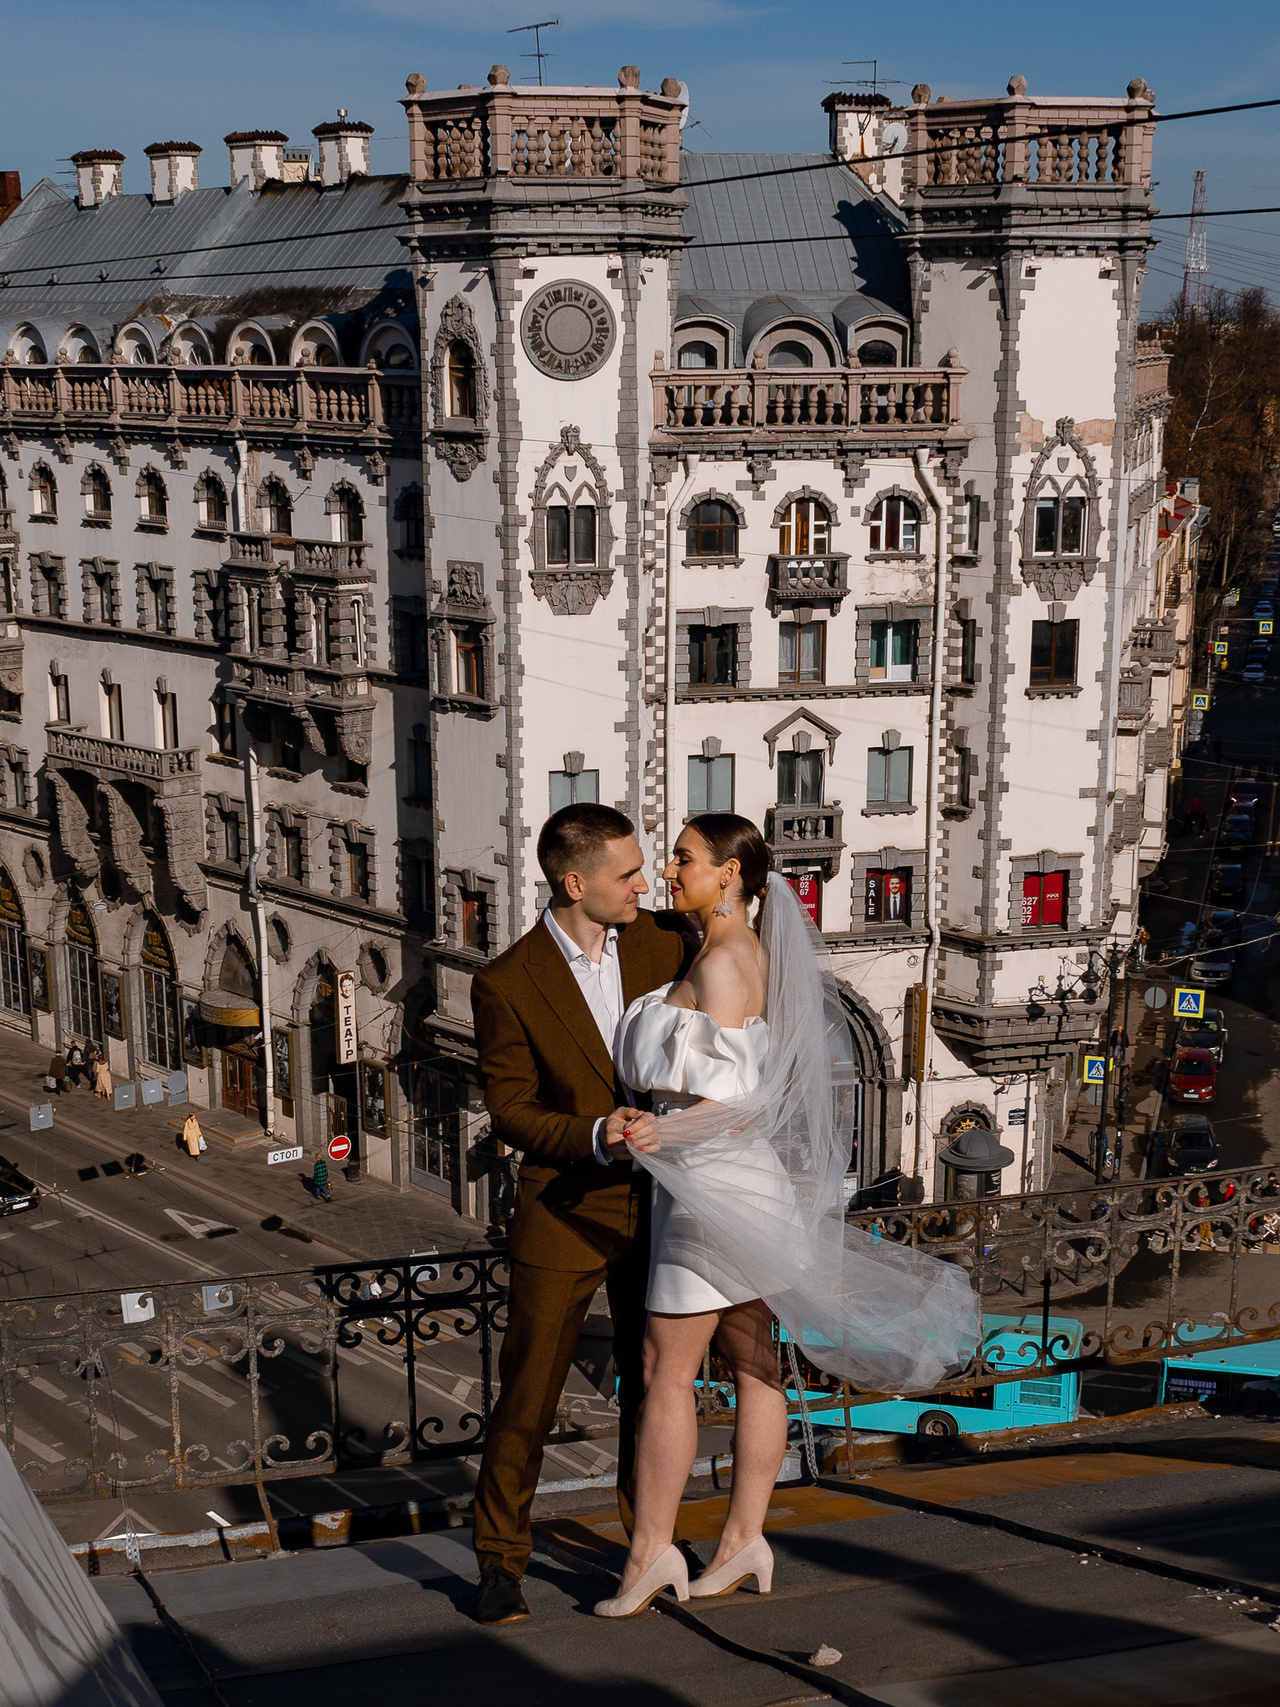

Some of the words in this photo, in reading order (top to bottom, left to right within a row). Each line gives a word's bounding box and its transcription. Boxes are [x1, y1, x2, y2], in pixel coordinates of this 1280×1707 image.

[868, 880, 876, 915] SALE
[1021, 896, 1039, 906] 627
[1021, 906, 1033, 915] 02
[1020, 915, 1033, 924] 67
[343, 1005, 354, 1060] ТЕАТР
[273, 1149, 298, 1162] СТОП
